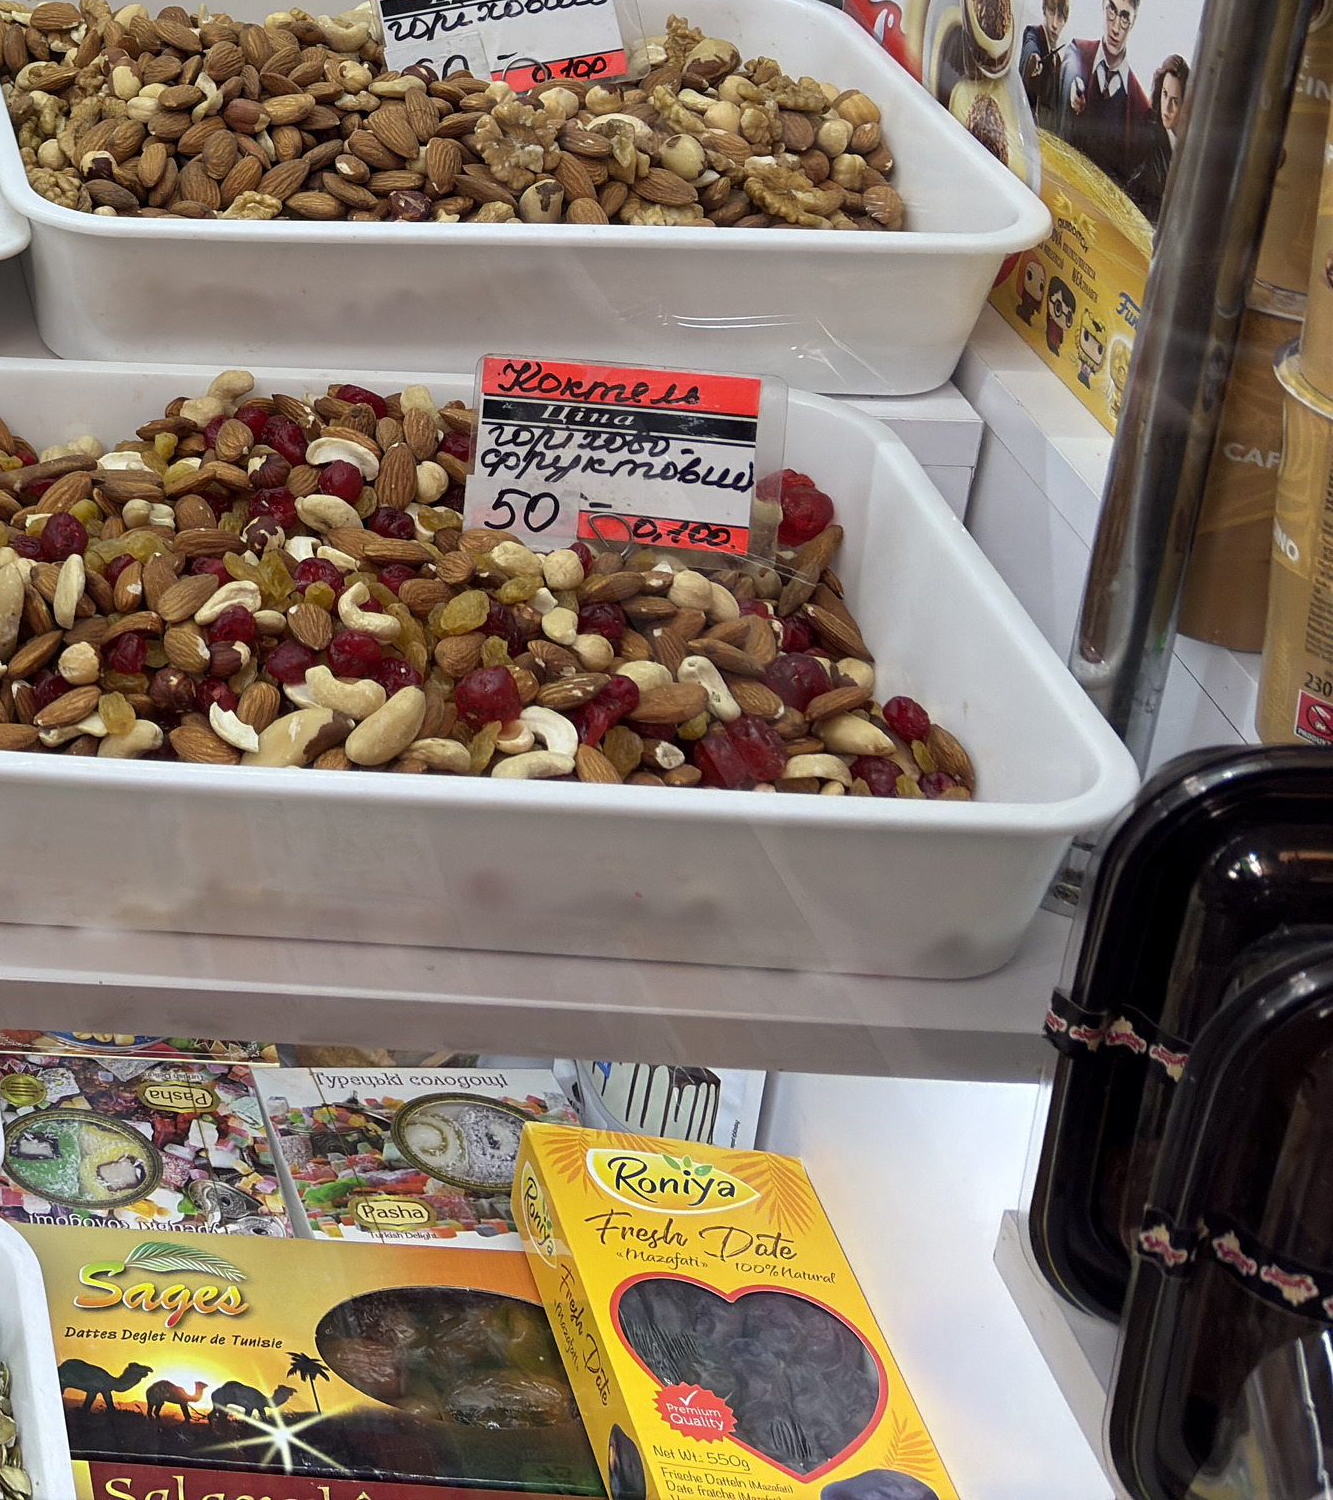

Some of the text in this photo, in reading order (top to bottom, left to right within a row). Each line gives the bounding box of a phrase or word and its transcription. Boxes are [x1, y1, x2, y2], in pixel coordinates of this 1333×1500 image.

[539, 405, 637, 427] Ціна
[483, 487, 560, 534] 50
[311, 1069, 510, 1092] Турецькі солодощі
[149, 1089, 208, 1106] Pasha
[605, 1155, 737, 1207] Roniya
[359, 1201, 428, 1221] Pasha
[524, 1175, 555, 1259] Roniya
[368, 1231, 439, 1244] Turkish Delight
[583, 1209, 798, 1262] Fresh Date
[780, 1266, 837, 1287] Natural
[73, 1259, 250, 1330] Sages
[64, 1325, 284, 1351] Dattes Deglet Nour de Tunisie
[666, 1403, 722, 1418] Premium
[670, 1413, 724, 1431] Quality
[653, 1444, 751, 1471] Net 550g
[661, 1467, 794, 1494] Frische Datteln (Mazafati)
